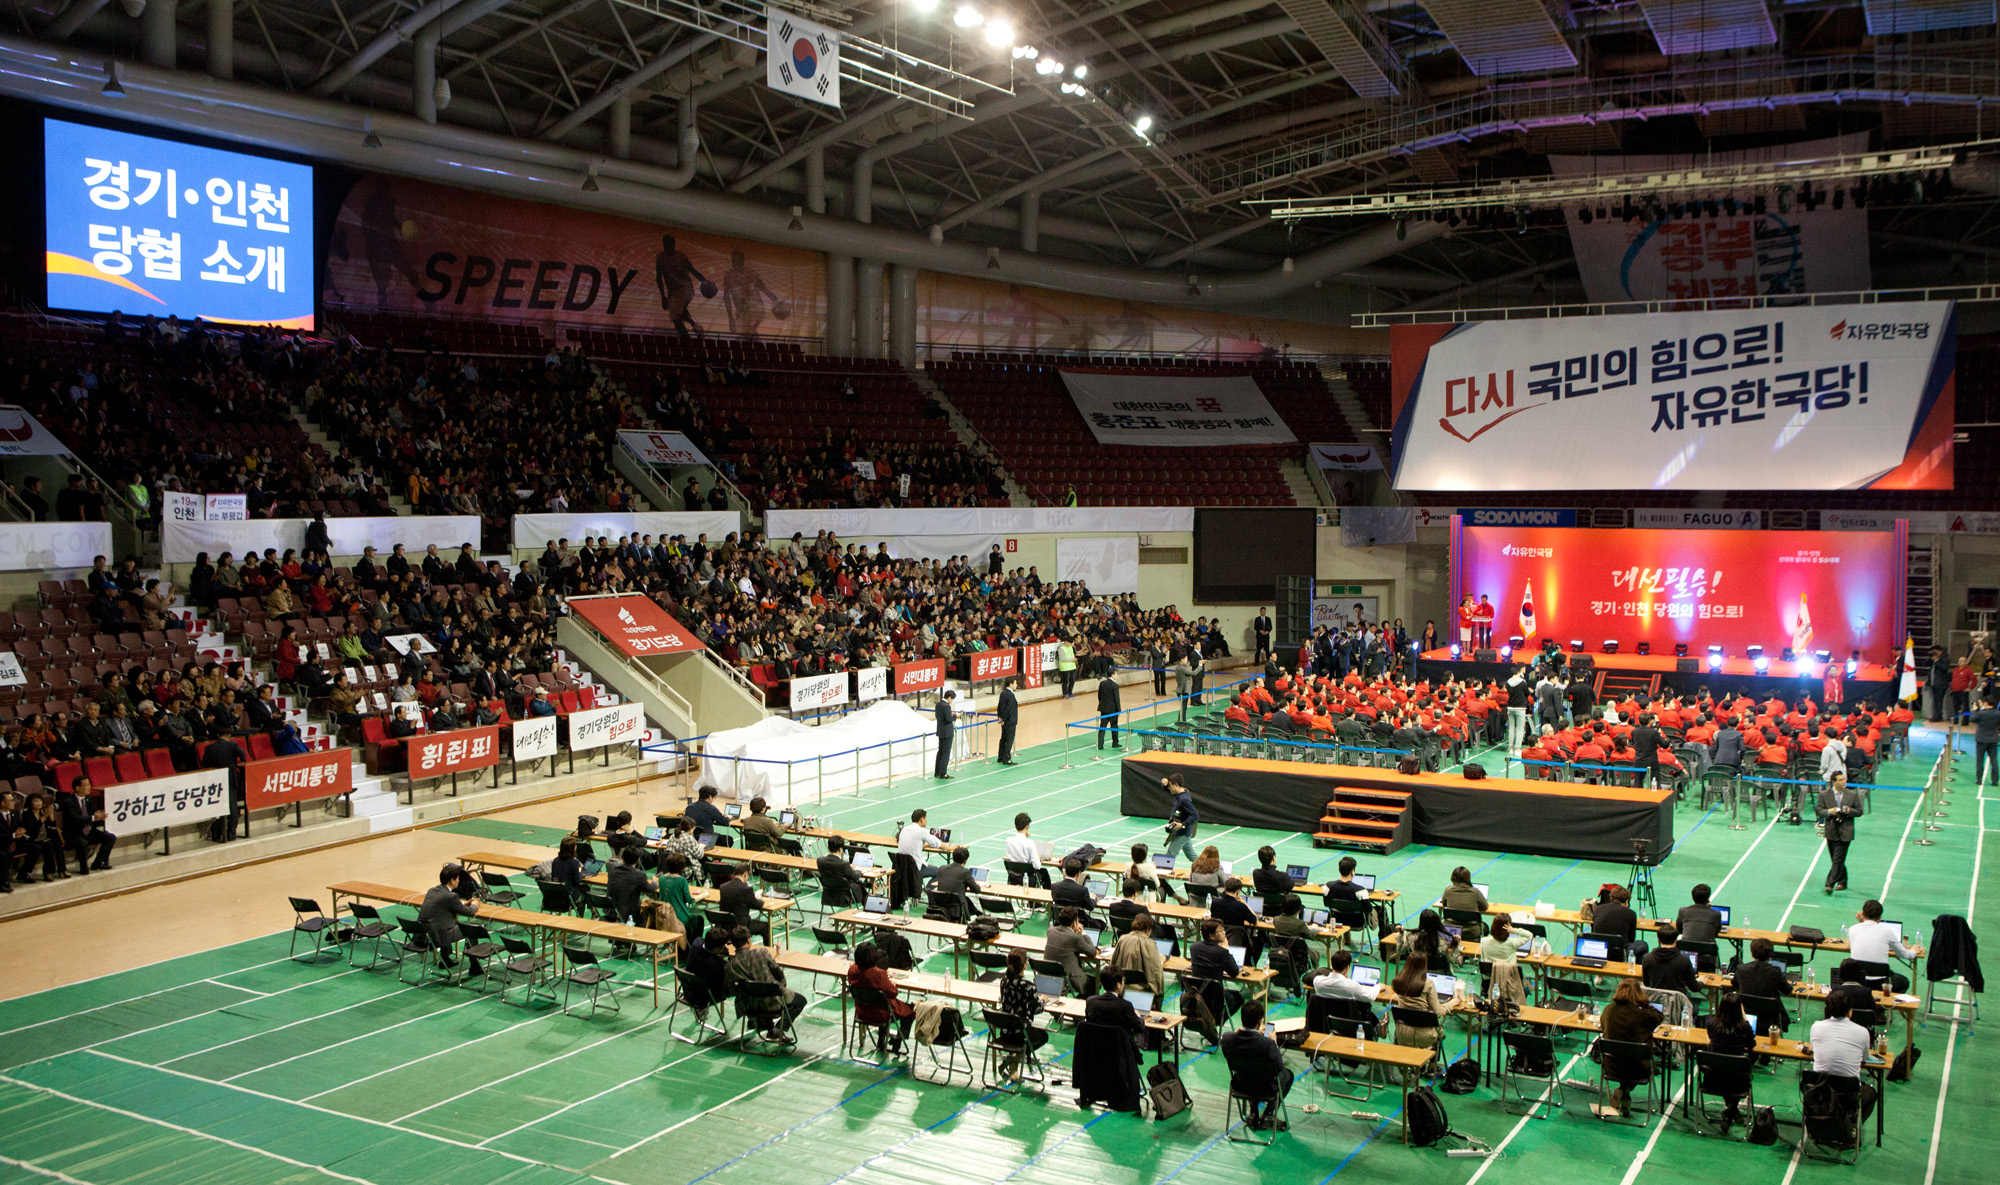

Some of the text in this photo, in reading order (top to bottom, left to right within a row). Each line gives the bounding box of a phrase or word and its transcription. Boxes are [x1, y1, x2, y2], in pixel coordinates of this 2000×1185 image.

[83, 157, 290, 233] 경기·인천
[89, 223, 285, 293] 당협 소개
[416, 251, 638, 314] SPEEDY
[1847, 322, 1930, 341] 자유한국당
[1445, 321, 1783, 418] 다시 국민의 힘으로!
[1112, 397, 1223, 413] 대한민국의 꿈
[1651, 361, 1868, 433] 자유한국당!
[1089, 412, 1166, 429] 홍준표
[1167, 417, 1232, 430] 대통령과
[643, 449, 697, 463] 정관장
[174, 507, 195, 521] 인천
[1683, 513, 1733, 525] FAGUO
[1008, 541, 1015, 551] 8
[1511, 547, 1553, 557] 자유한국당
[1612, 566, 1723, 600] 대선필승!
[1591, 601, 1744, 619] 경기·인천 당원의 힘으로!
[627, 634, 684, 651] 경기도당
[1001, 655, 1014, 670] 표!
[903, 667, 938, 684] 서민대통령
[796, 677, 830, 702] 경기당원의
[821, 684, 844, 704] 힘으로!
[577, 709, 620, 740] 경기당원의
[609, 716, 637, 741] 힘으로!
[516, 723, 555, 750] 대선필승!
[420, 735, 491, 769] 홍! 준! 표!
[262, 762, 338, 793] 서민대통령
[112, 782, 223, 822] 강하고 당당한
